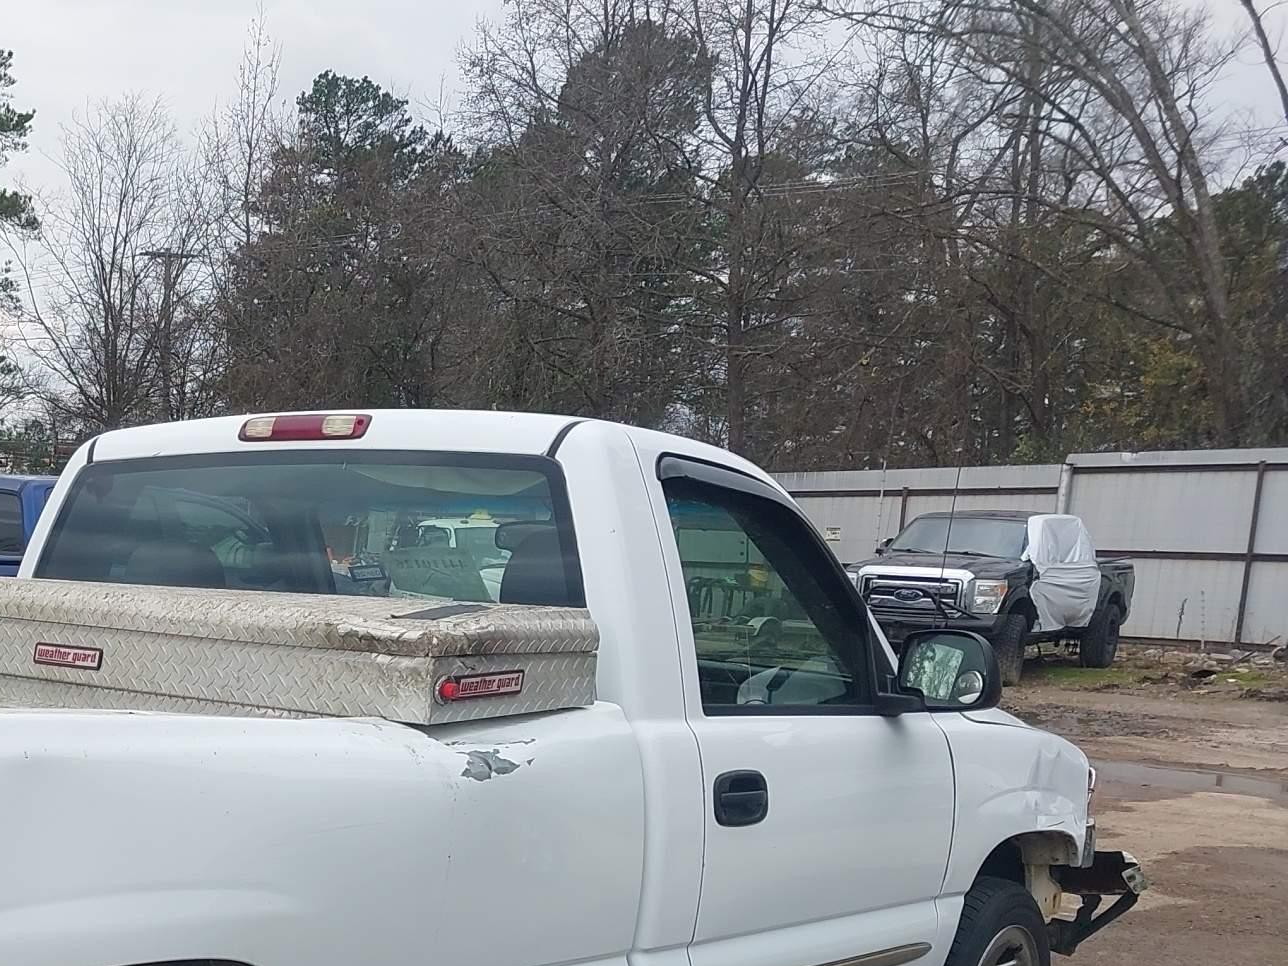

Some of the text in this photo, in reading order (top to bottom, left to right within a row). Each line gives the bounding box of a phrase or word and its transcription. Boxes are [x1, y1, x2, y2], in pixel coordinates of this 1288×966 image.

[37, 647, 97, 664] weather guard
[461, 674, 521, 692] weather guard
